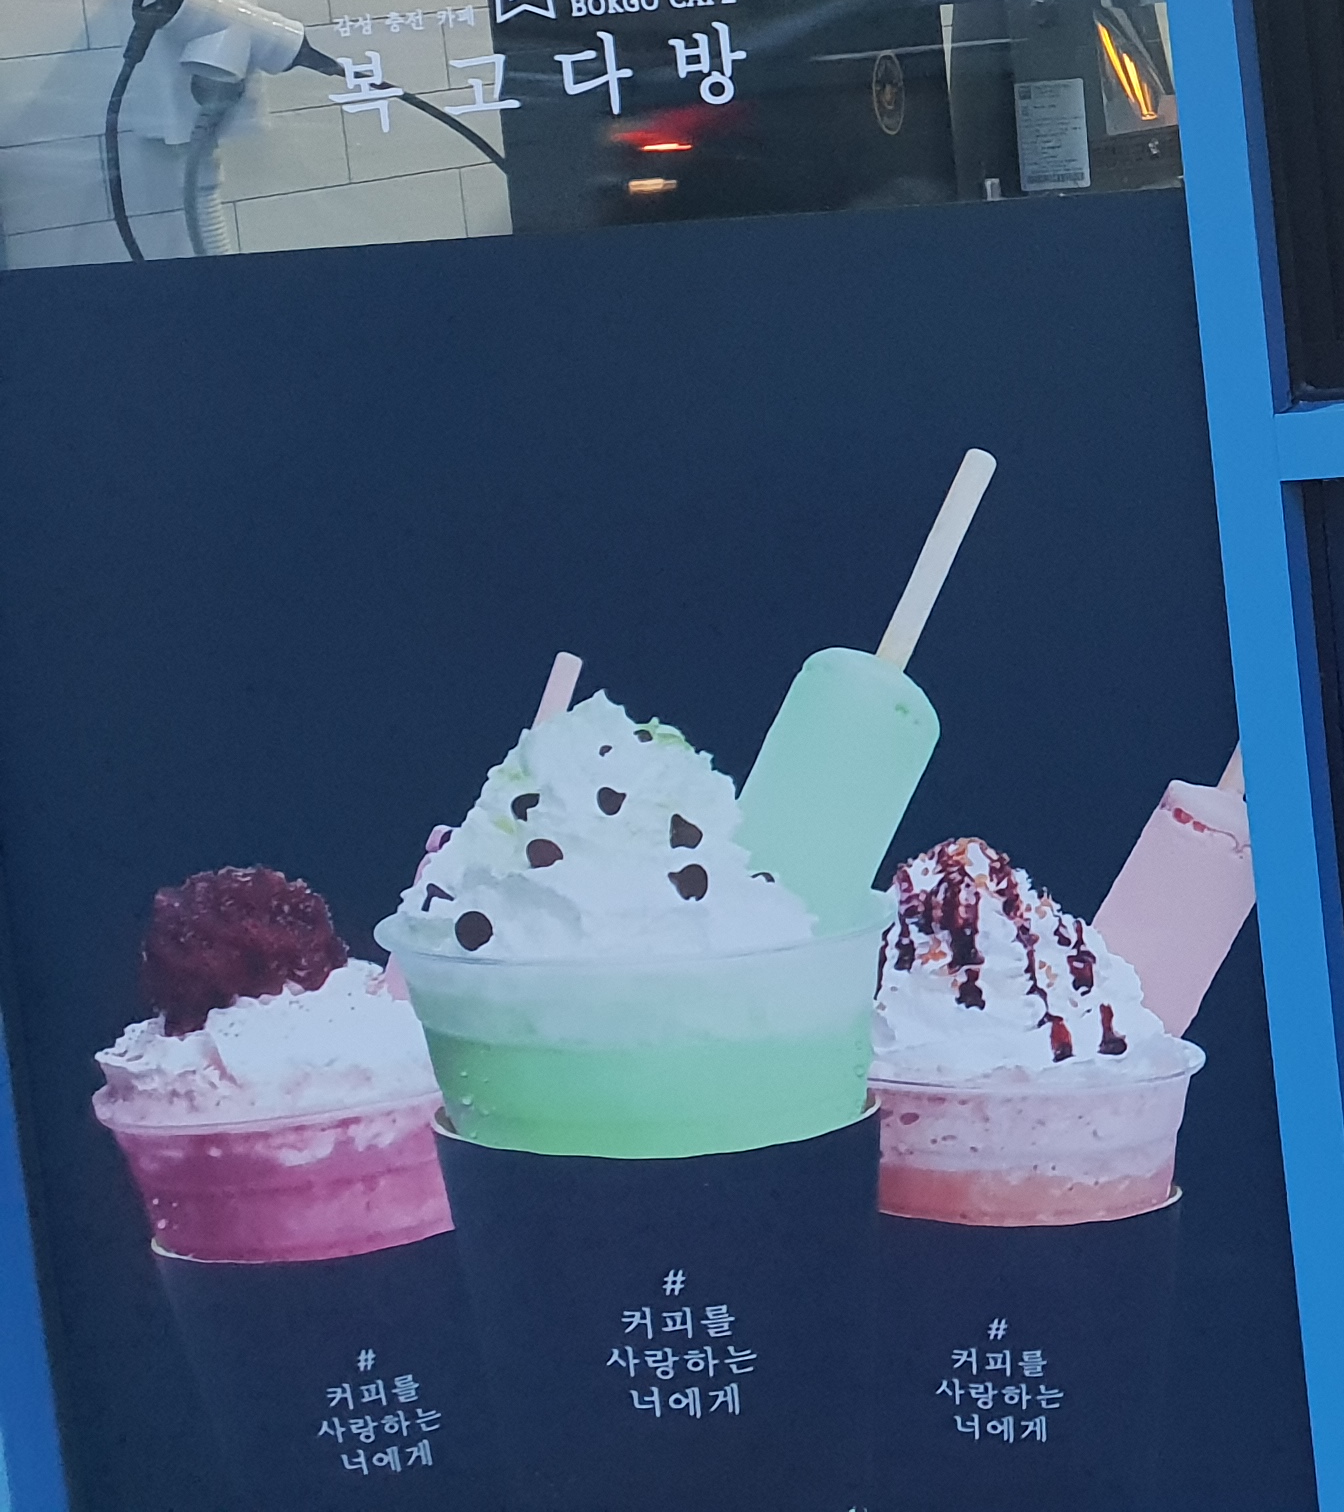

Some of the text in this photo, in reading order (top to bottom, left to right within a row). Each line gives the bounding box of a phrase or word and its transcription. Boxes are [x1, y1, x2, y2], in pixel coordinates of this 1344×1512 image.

[333, 5, 475, 37] 감성 충전 카페
[662, 1269, 686, 1297] #
[620, 1304, 737, 1340] 커피를
[987, 1318, 1008, 1341] #
[358, 1348, 376, 1372] #
[605, 1345, 759, 1380] 사랑하는
[950, 1347, 1048, 1379] 커피를
[325, 1375, 420, 1410] 커피를
[630, 1383, 742, 1421] 너에게
[934, 1377, 1065, 1412] 사랑하는
[316, 1407, 443, 1444] 사랑하는
[952, 1412, 1049, 1444] 너에게
[341, 1439, 434, 1477] 너에게
